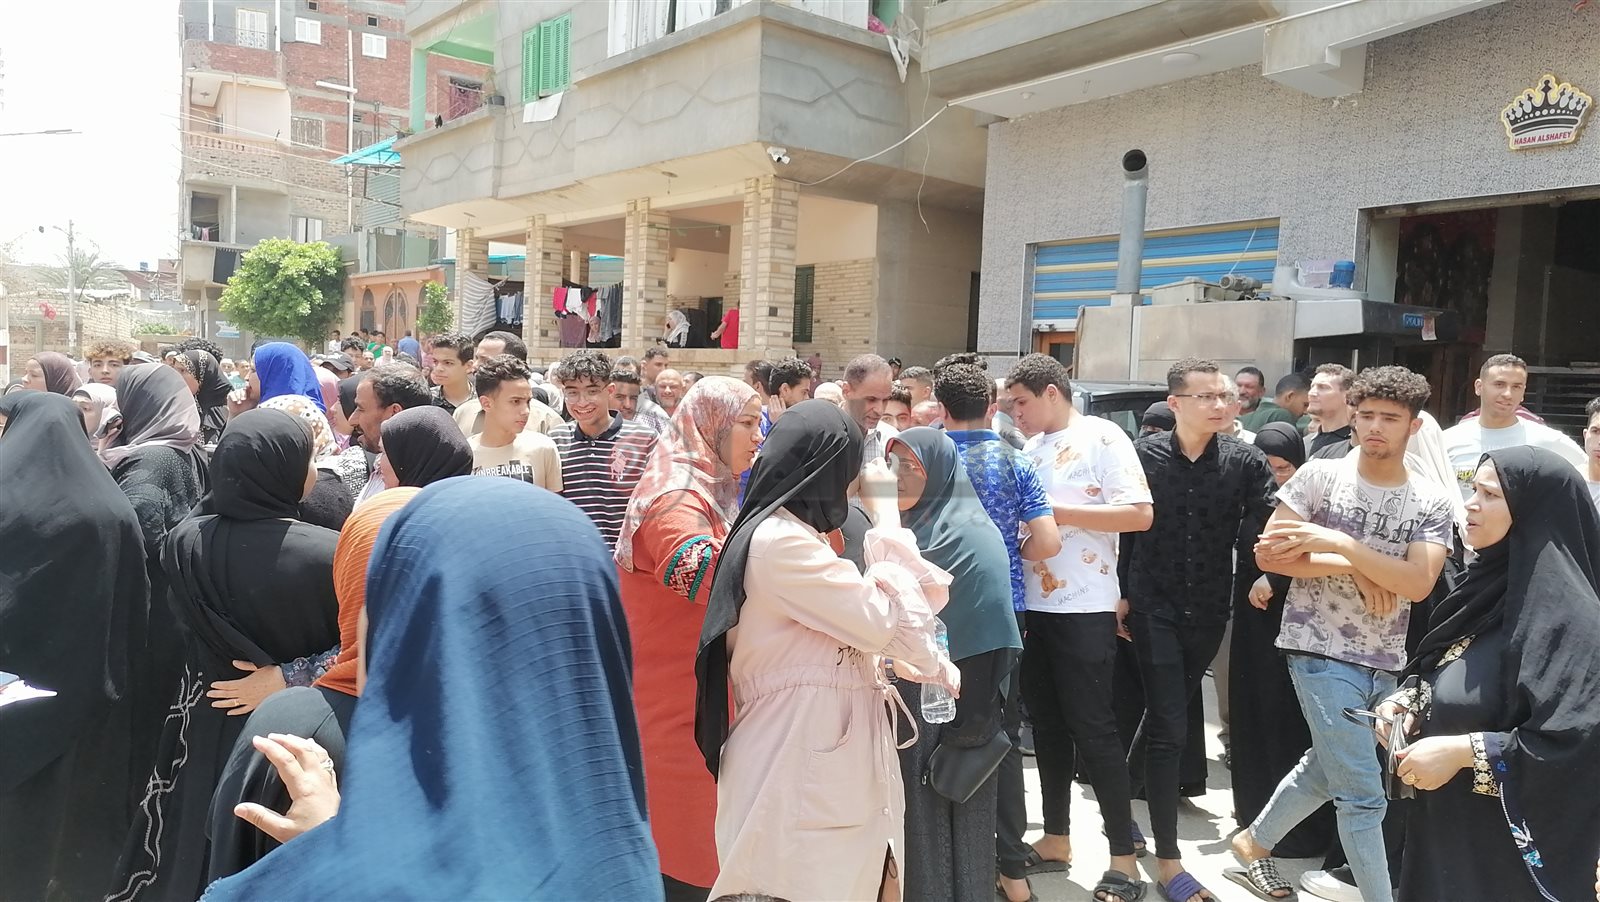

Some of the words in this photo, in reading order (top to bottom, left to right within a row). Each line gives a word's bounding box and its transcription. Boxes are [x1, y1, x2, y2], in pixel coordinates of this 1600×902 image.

[1514, 136, 1536, 145] HASAN
[1537, 131, 1572, 142] ALSHAFEY
[1058, 585, 1090, 606] MACHINE
